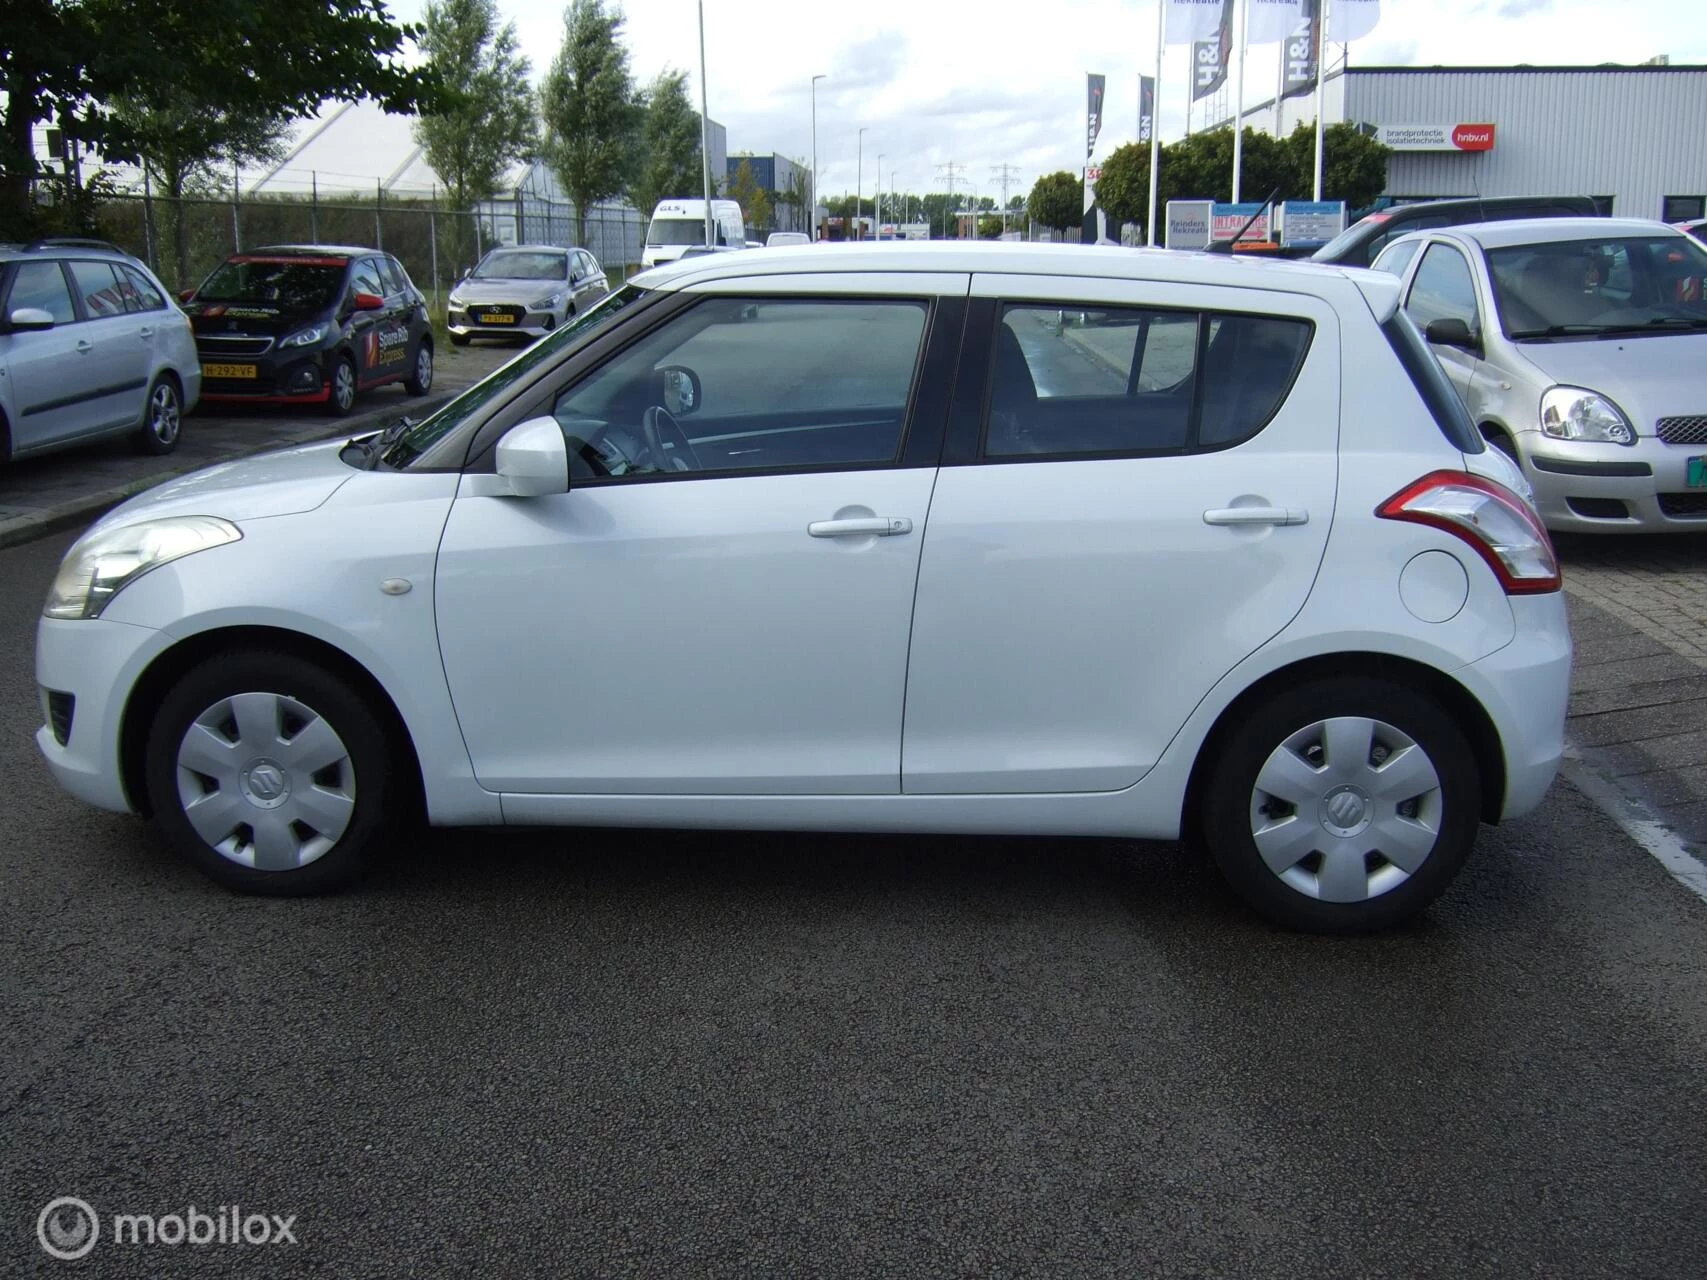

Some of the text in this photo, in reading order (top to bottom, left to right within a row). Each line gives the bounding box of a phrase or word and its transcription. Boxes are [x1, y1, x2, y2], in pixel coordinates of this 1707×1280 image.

[1140, 115, 1152, 144] &N
[1386, 129, 1444, 139] brandprotectie
[1386, 137, 1446, 145] isolatietechniek
[1457, 133, 1489, 142] hnbv.nl
[1171, 219, 1205, 227] Reinders
[379, 326, 408, 350] Spare Rib
